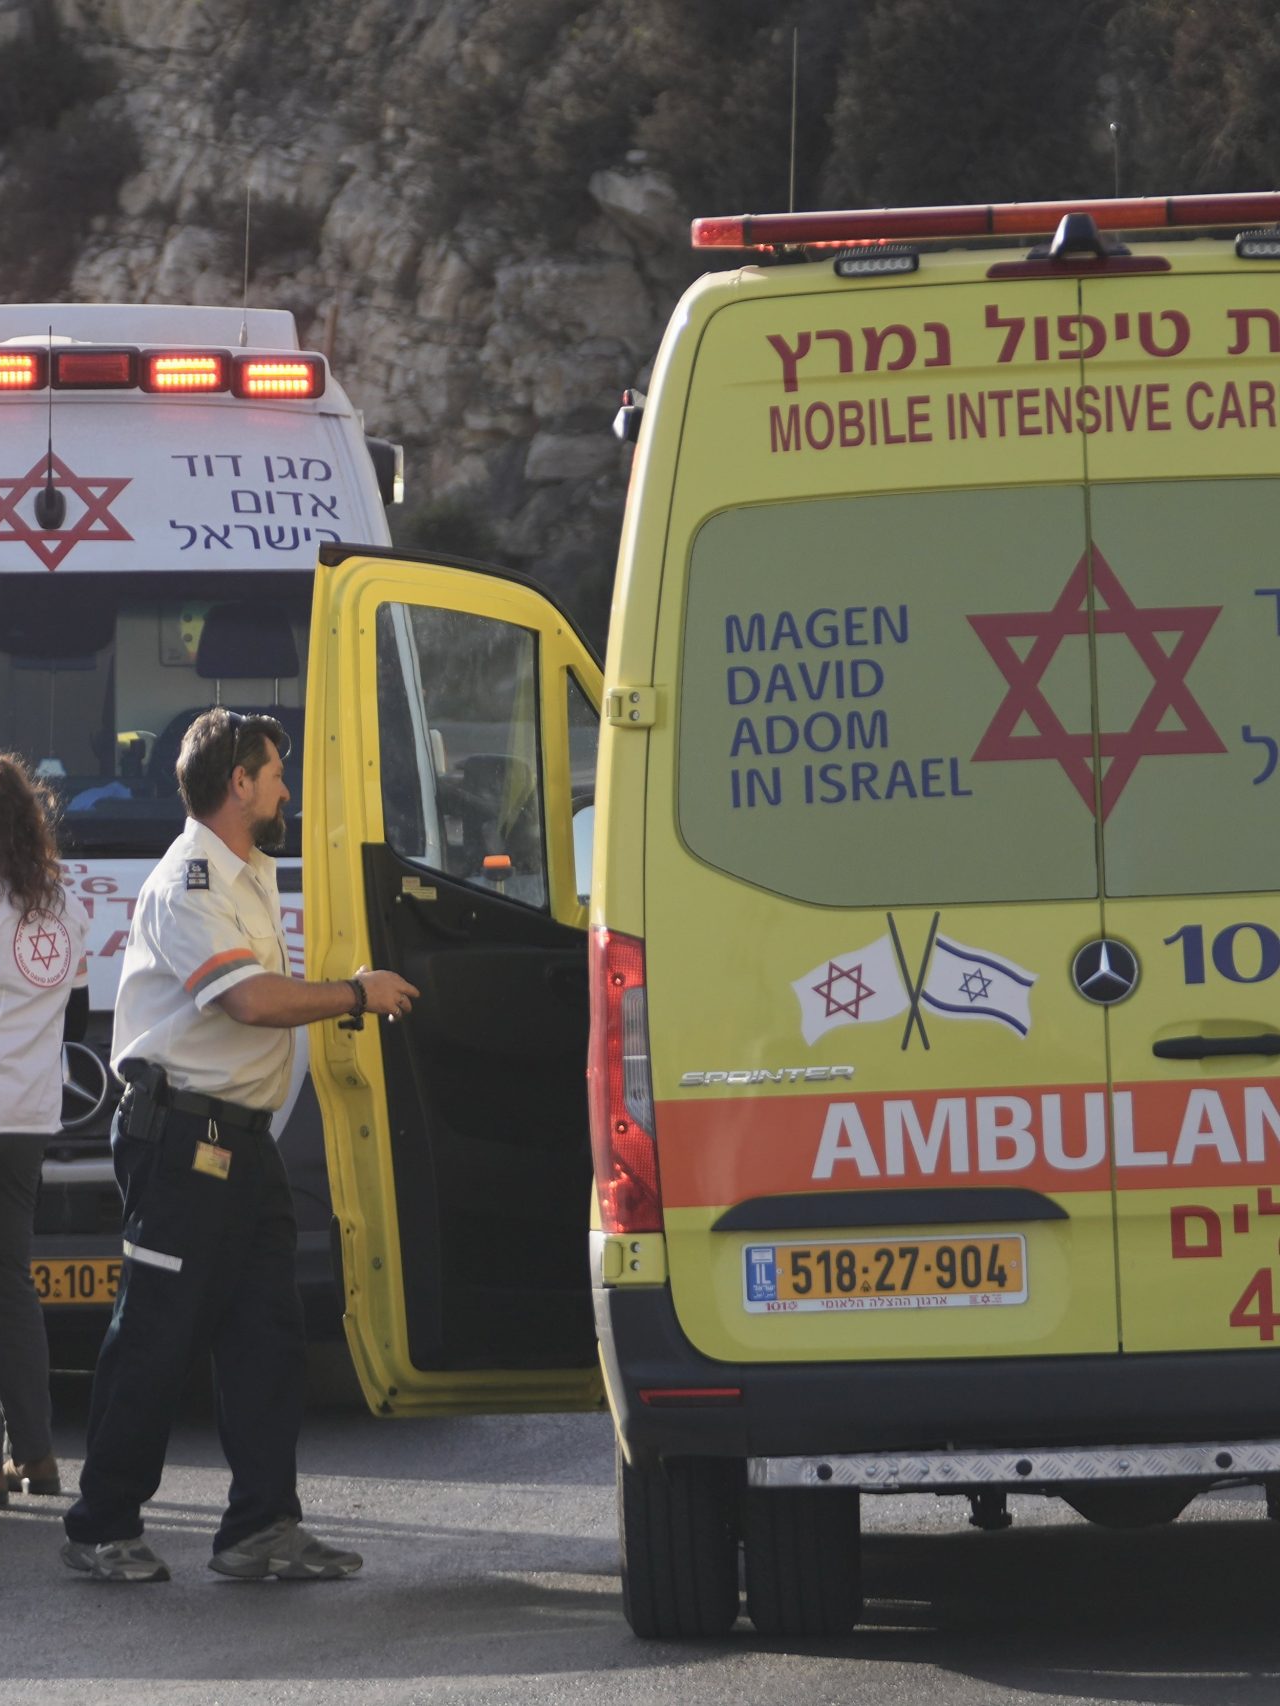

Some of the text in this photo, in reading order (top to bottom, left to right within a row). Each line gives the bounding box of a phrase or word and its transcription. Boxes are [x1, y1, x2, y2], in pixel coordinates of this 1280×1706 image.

[765, 321, 952, 393] נמרץ
[984, 304, 1191, 363] טיפול
[769, 380, 1278, 454] MOBILE INTENSIVE CAR
[170, 454, 333, 483] מגן דוד
[230, 489, 341, 521] אדום
[725, 604, 909, 654] MAGEN
[727, 658, 885, 706] DAVID
[729, 709, 889, 758] ADOM
[730, 757, 973, 809] IN ISRAEL
[679, 1065, 855, 1088] SPRINTER
[755, 1263, 772, 1285] IL
